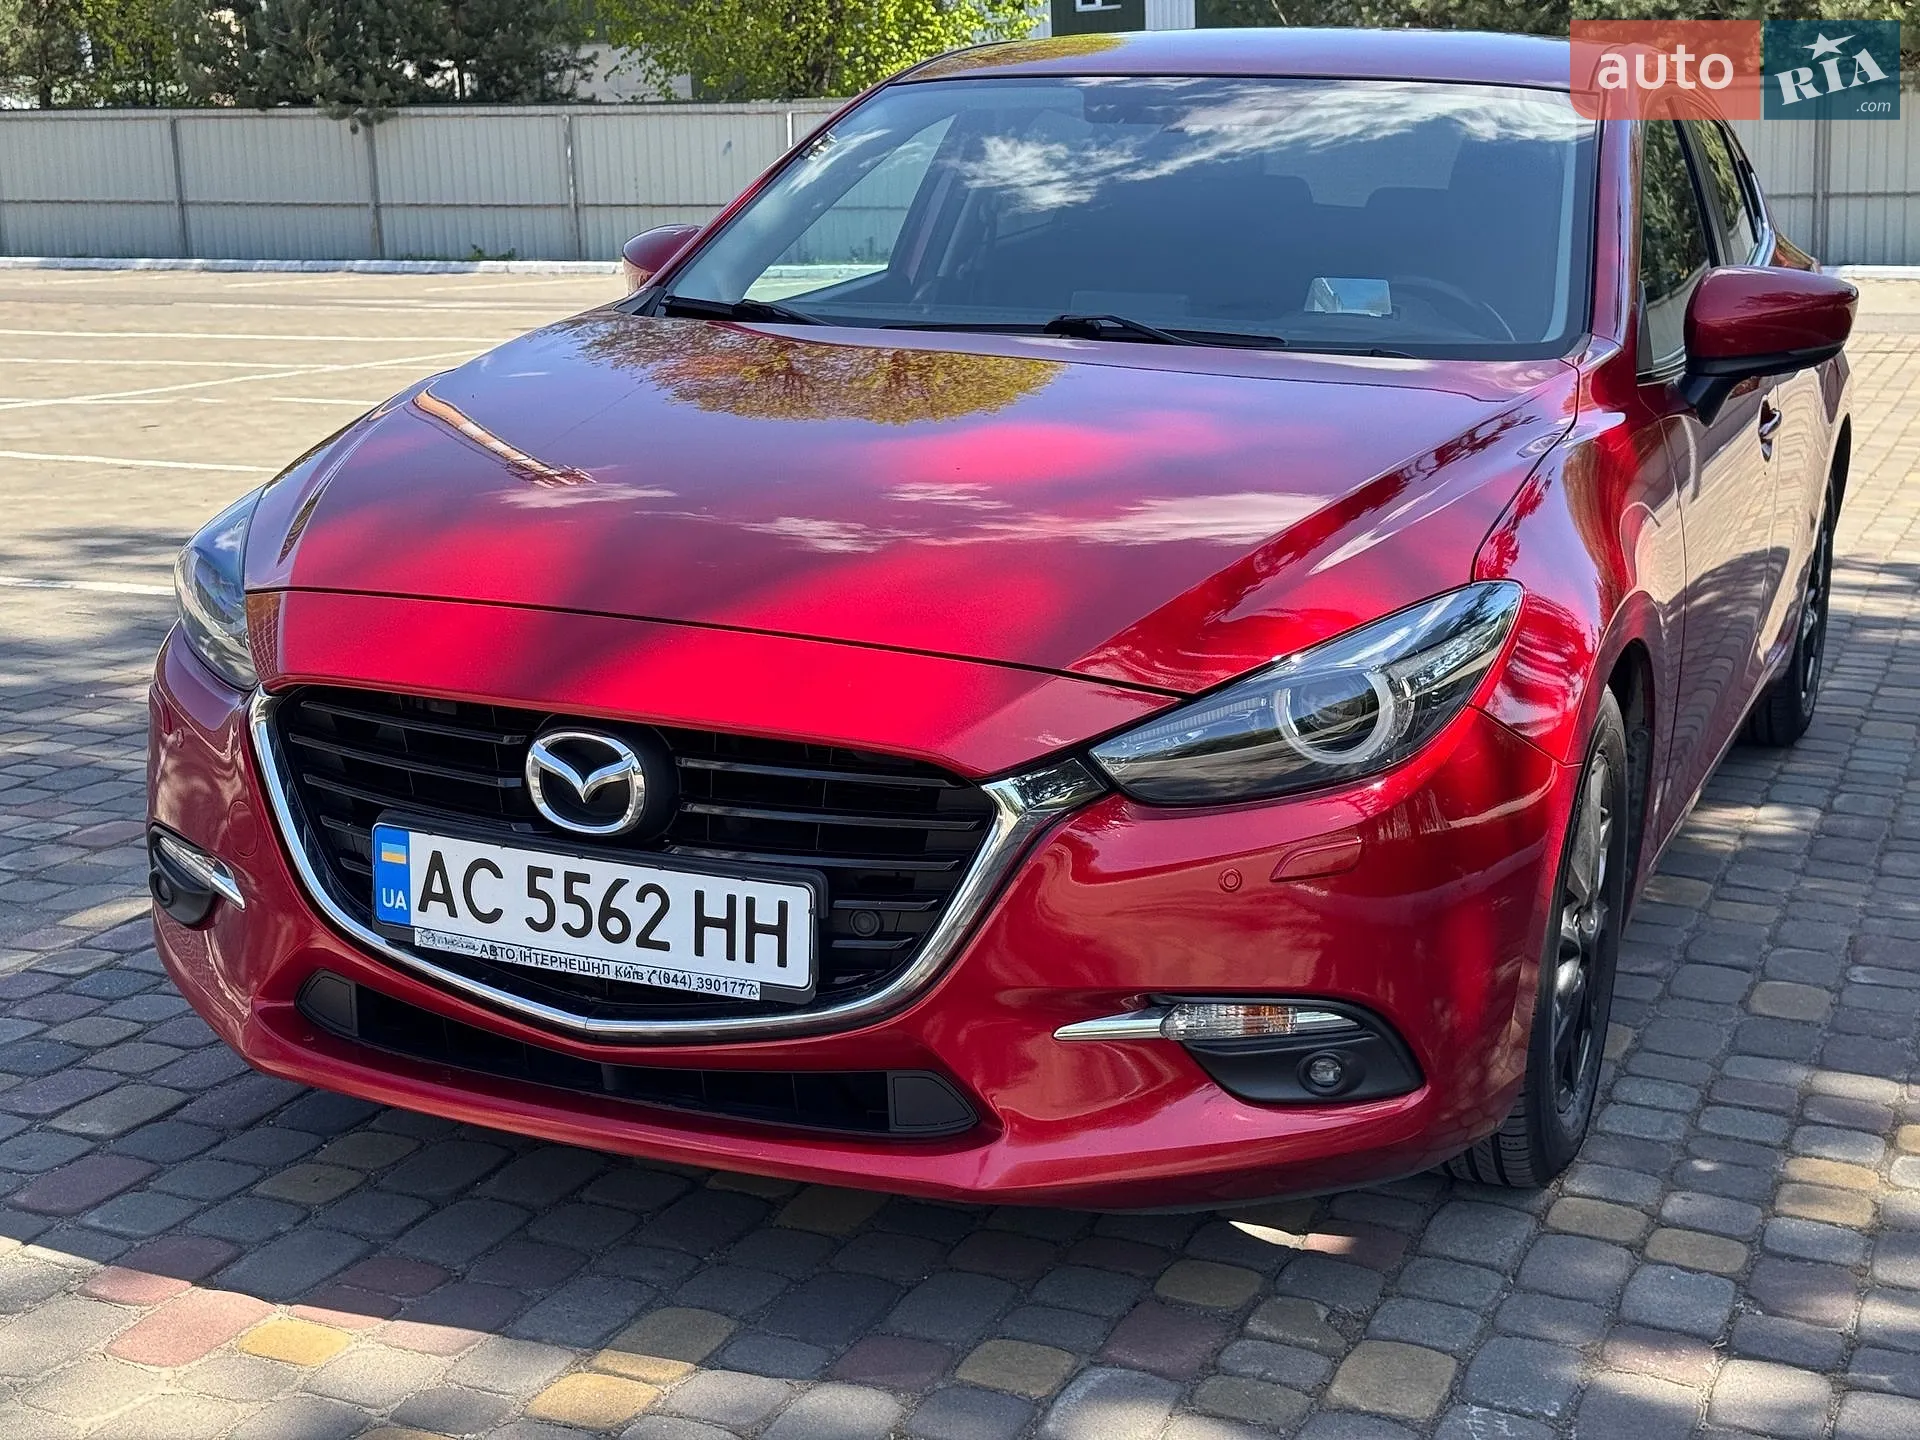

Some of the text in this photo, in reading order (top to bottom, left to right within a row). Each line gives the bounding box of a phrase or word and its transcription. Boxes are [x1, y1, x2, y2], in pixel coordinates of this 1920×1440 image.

[382, 888, 408, 911] UA
[418, 850, 788, 968] AC 5562 HH
